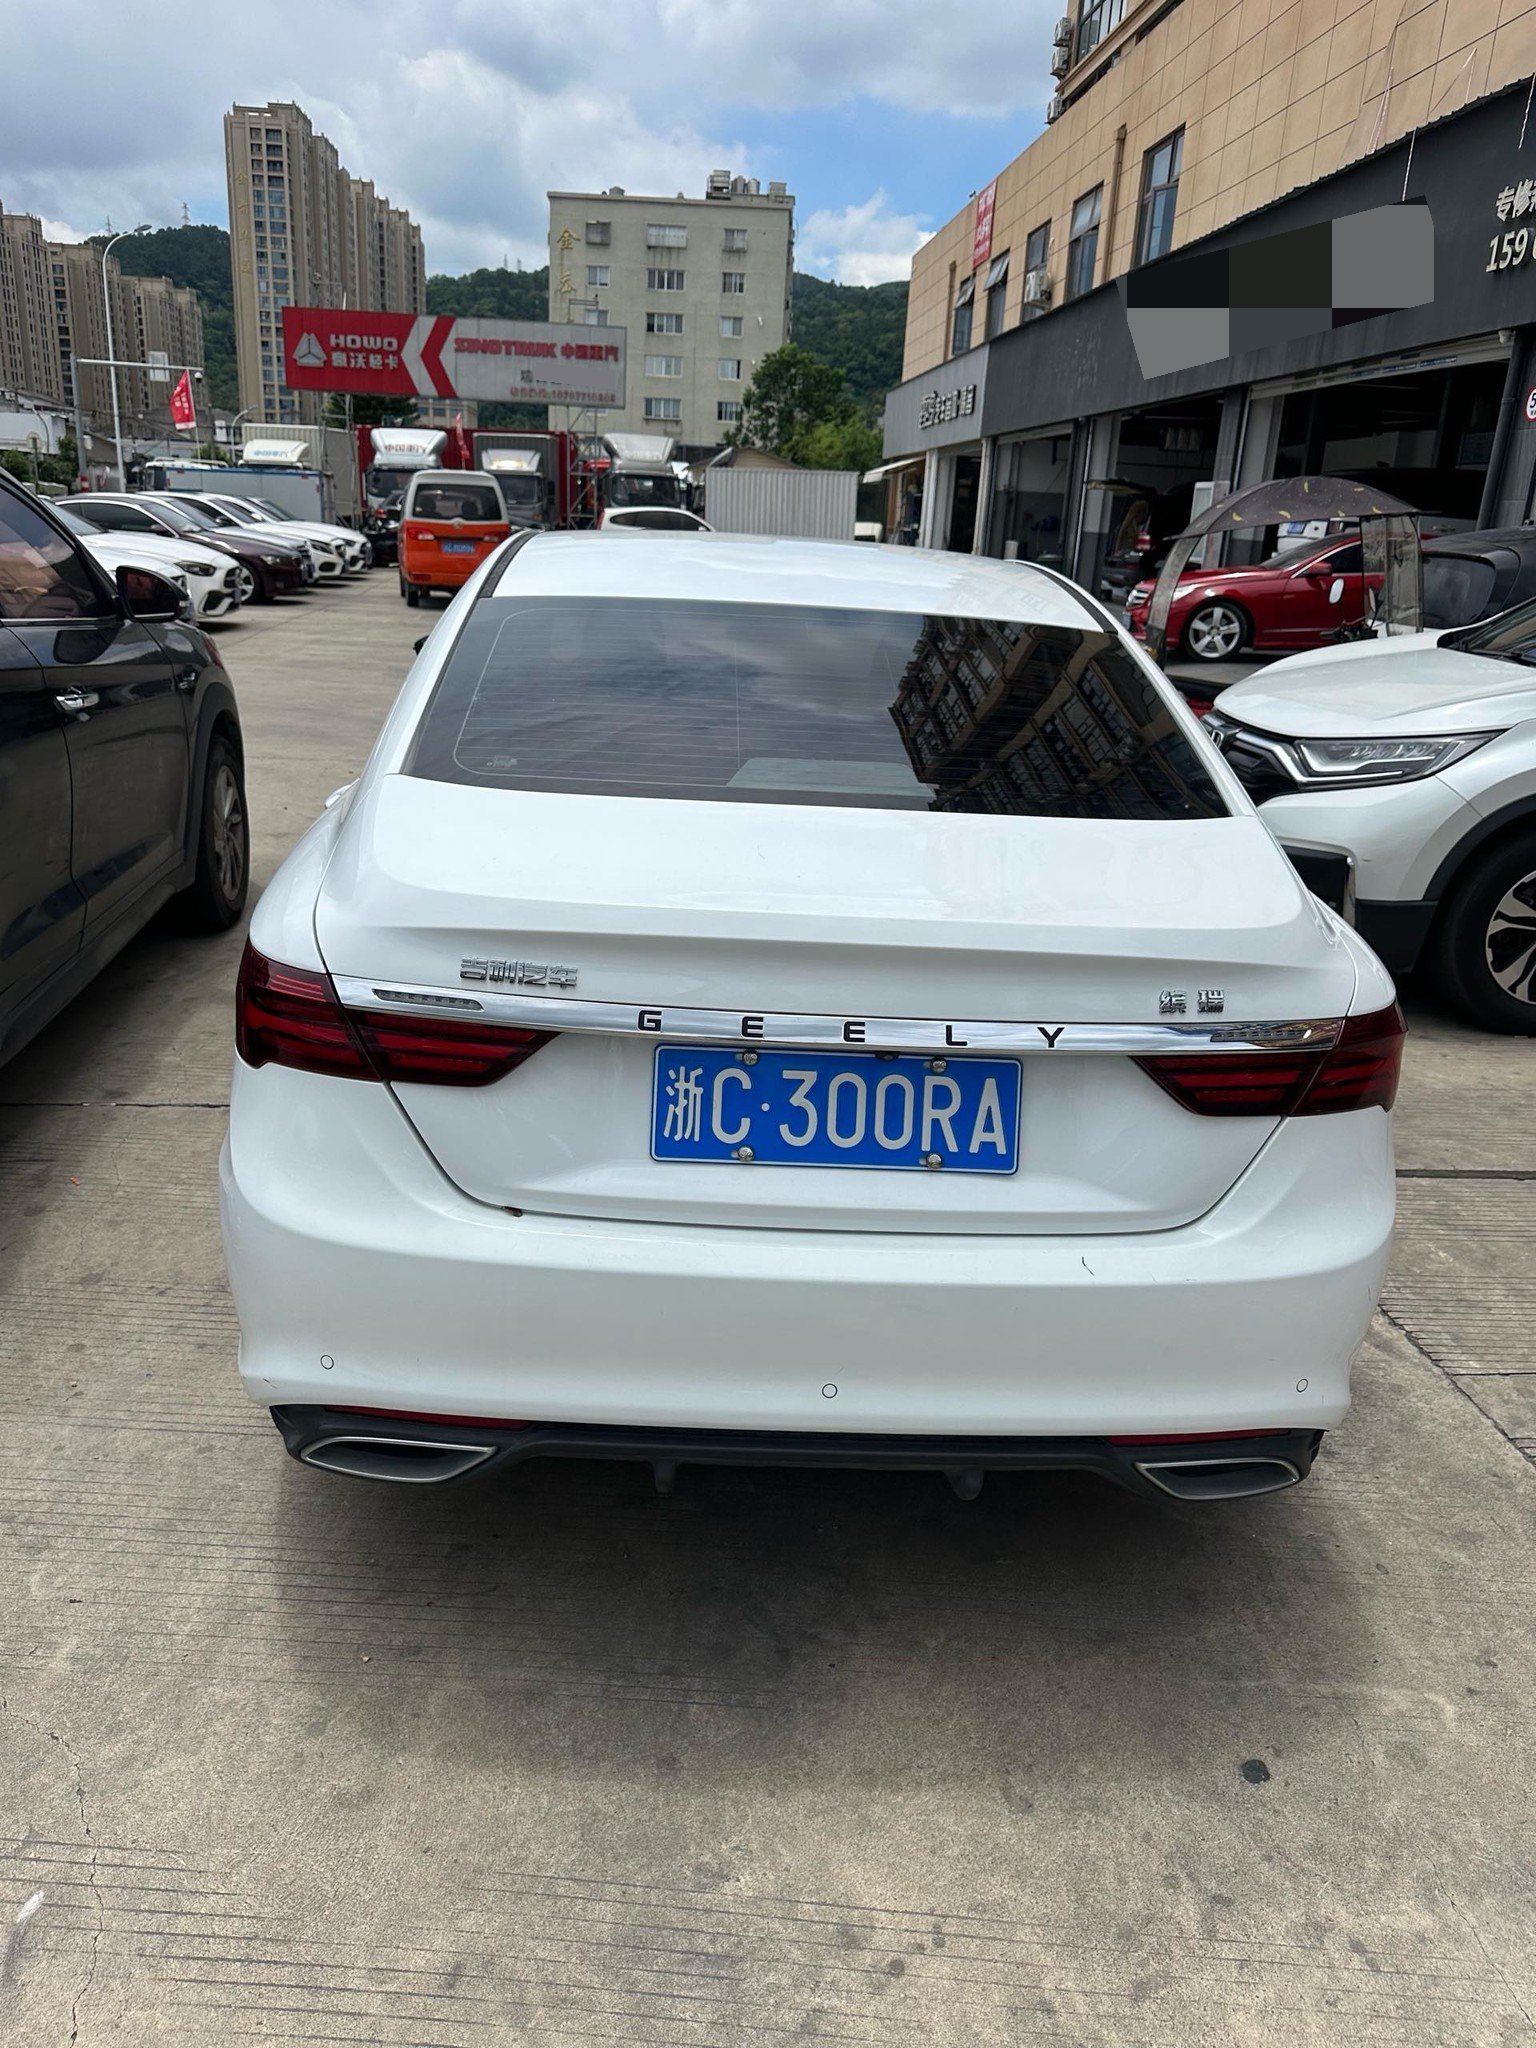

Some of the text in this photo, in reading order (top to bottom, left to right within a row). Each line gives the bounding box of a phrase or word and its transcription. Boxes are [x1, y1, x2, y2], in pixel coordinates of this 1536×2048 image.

[1486, 227, 1529, 272] 159
[329, 333, 399, 351] HOWO
[331, 351, 399, 369] 豪沃轻卡
[460, 957, 578, 987] 吉利汽车
[1160, 989, 1224, 1014] 缤瑞
[637, 1010, 1065, 1048] GEELY
